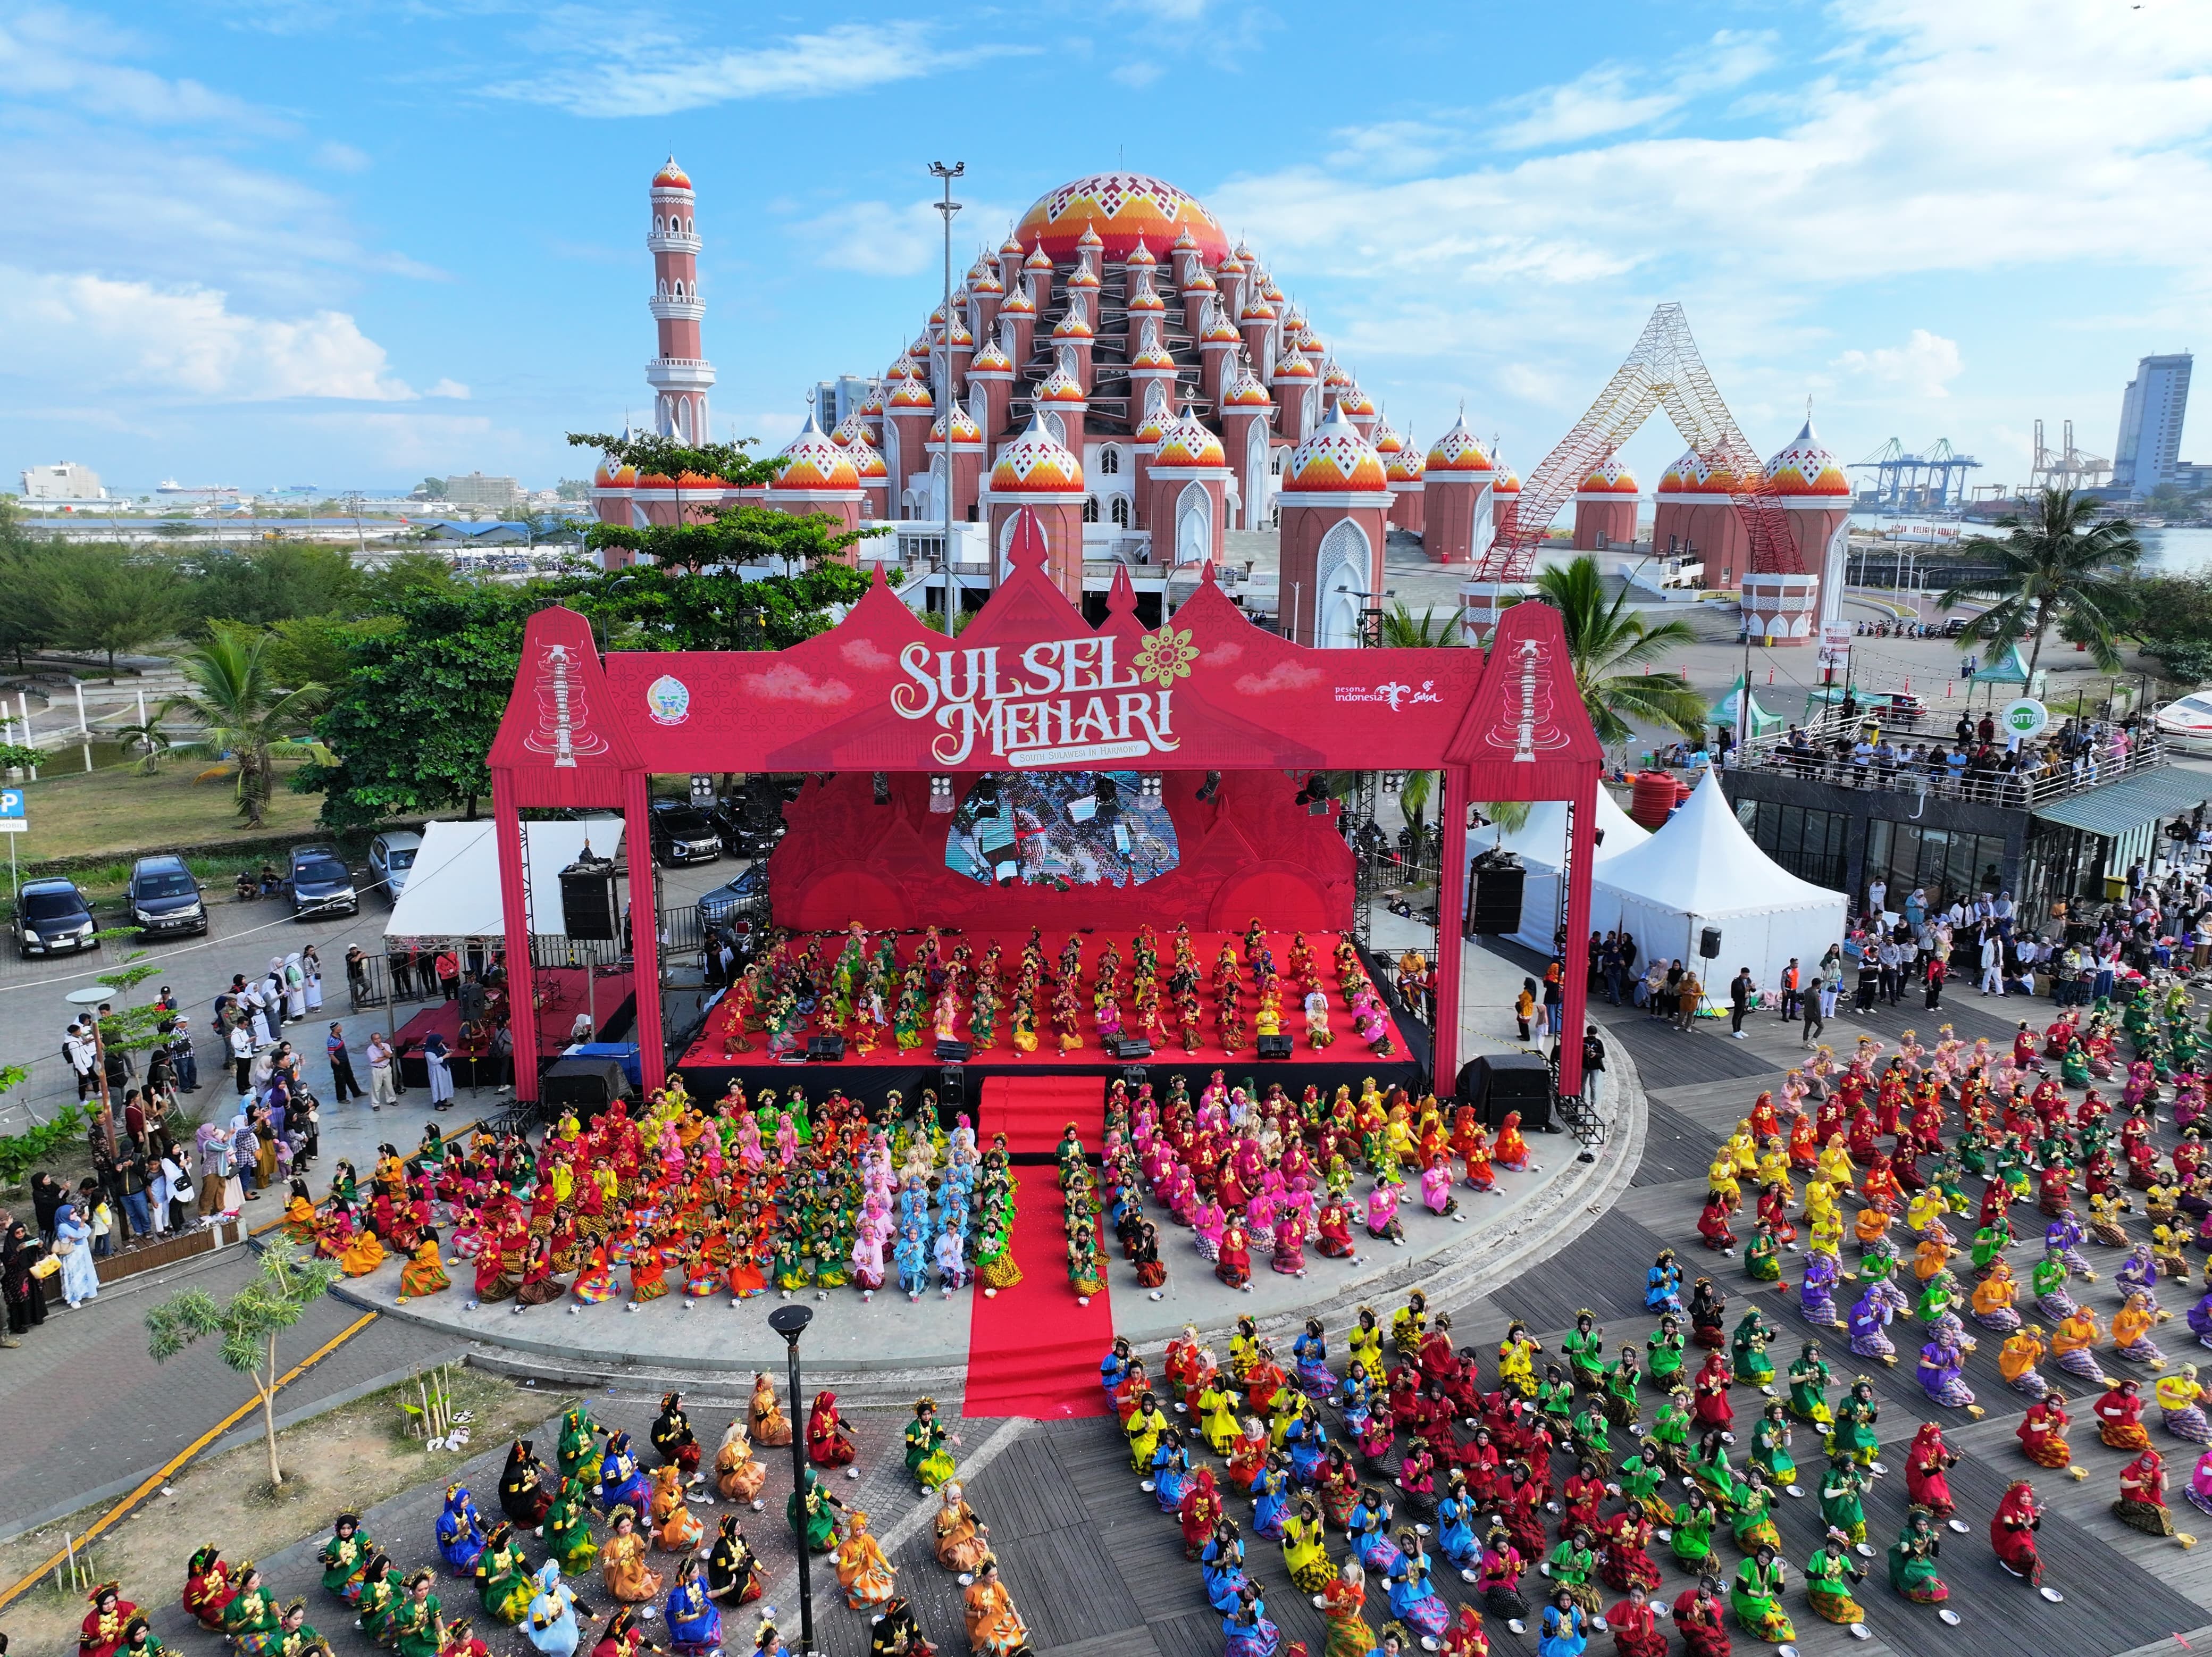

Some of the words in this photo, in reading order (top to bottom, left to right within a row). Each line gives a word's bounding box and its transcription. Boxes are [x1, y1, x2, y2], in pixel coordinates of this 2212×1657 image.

[891, 635, 1139, 719] SULSEL
[1335, 693, 1384, 701] indonesia
[1409, 691, 1444, 704] Sulsel
[932, 690, 1180, 766] MENARI
[2005, 713, 2043, 725] YOTTA!
[1019, 754, 1045, 762] SOUTH
[1049, 751, 1085, 760] SULAWESI
[1100, 744, 1138, 756] HARMONY
[1, 793, 18, 813] P
